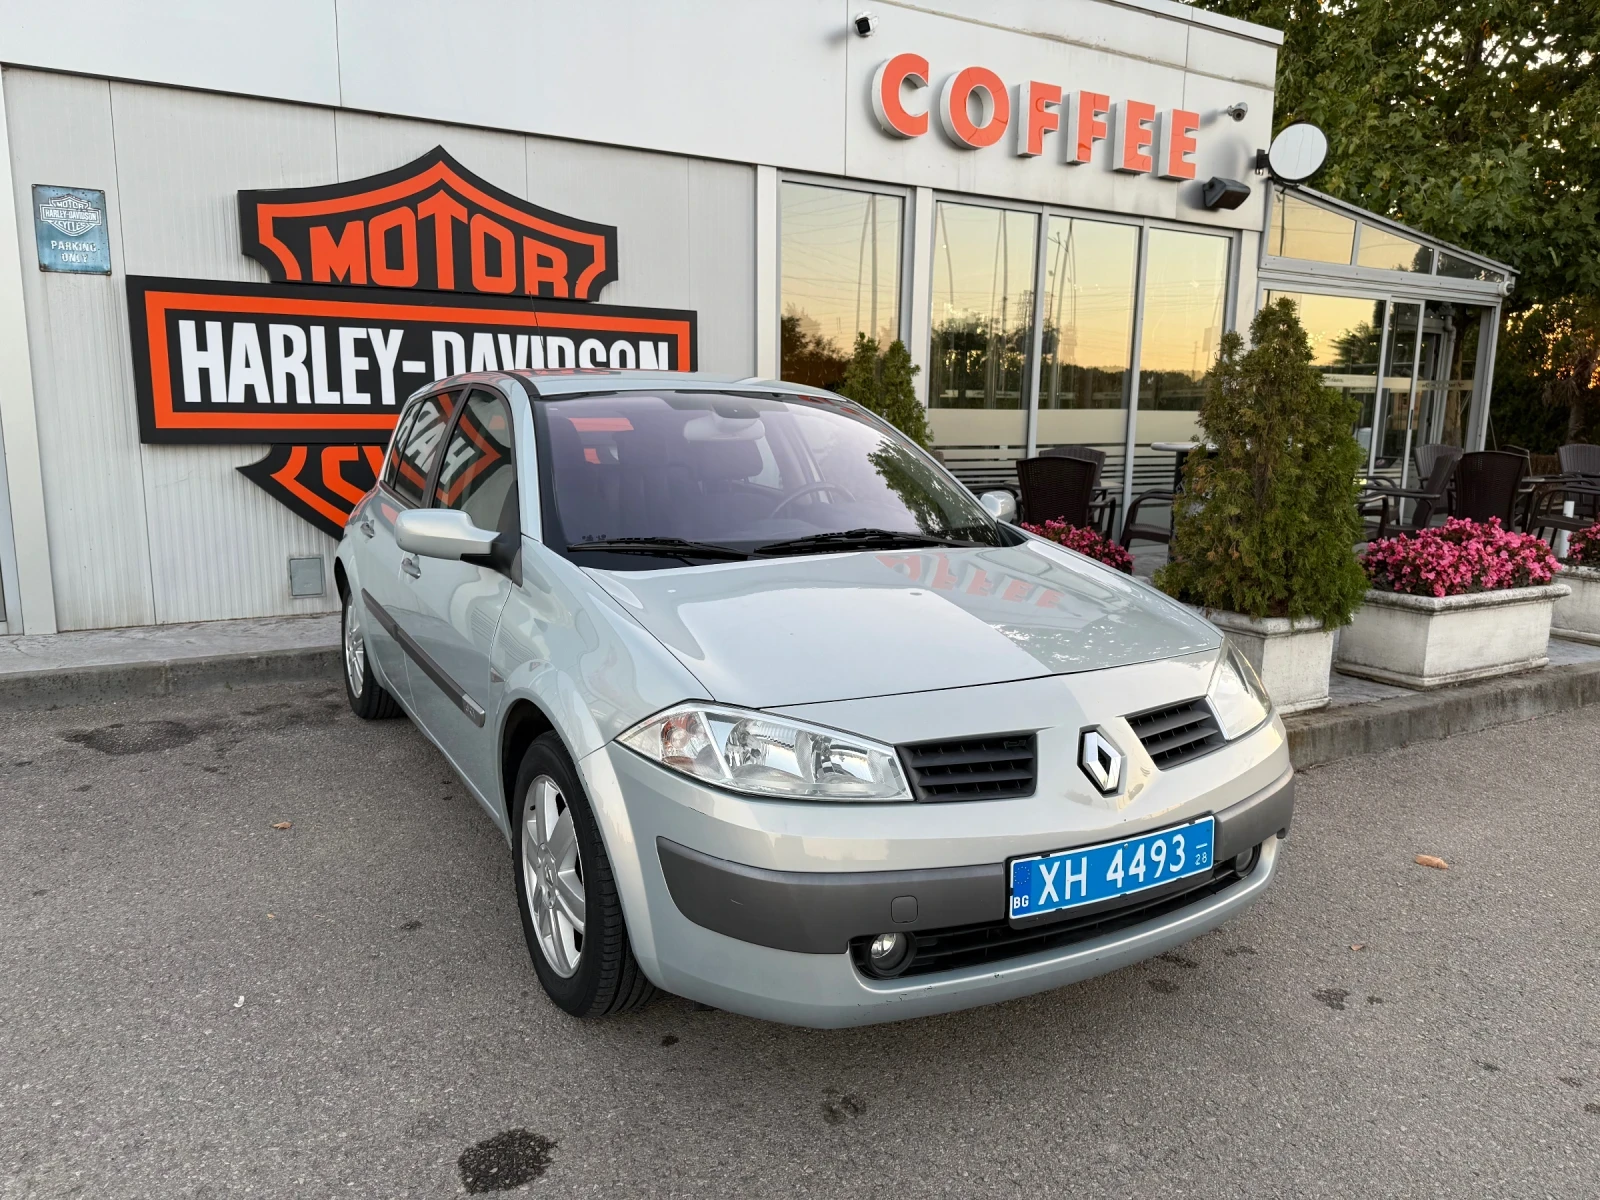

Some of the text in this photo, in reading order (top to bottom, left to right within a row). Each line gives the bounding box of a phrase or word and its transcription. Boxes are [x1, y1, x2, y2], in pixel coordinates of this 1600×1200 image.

[873, 52, 1200, 181] COFFEE
[56, 199, 86, 210] MOTOR
[45, 208, 97, 221] HARLEY-DAVIDSON
[57, 221, 87, 232] CYCLES
[50, 240, 97, 252] PARKING
[310, 189, 569, 299] MOTOR
[61, 252, 88, 263] ONLY
[1194, 852, 1208, 867] 28
[1038, 833, 1186, 906] XH 4493
[1013, 895, 1030, 910] BG
